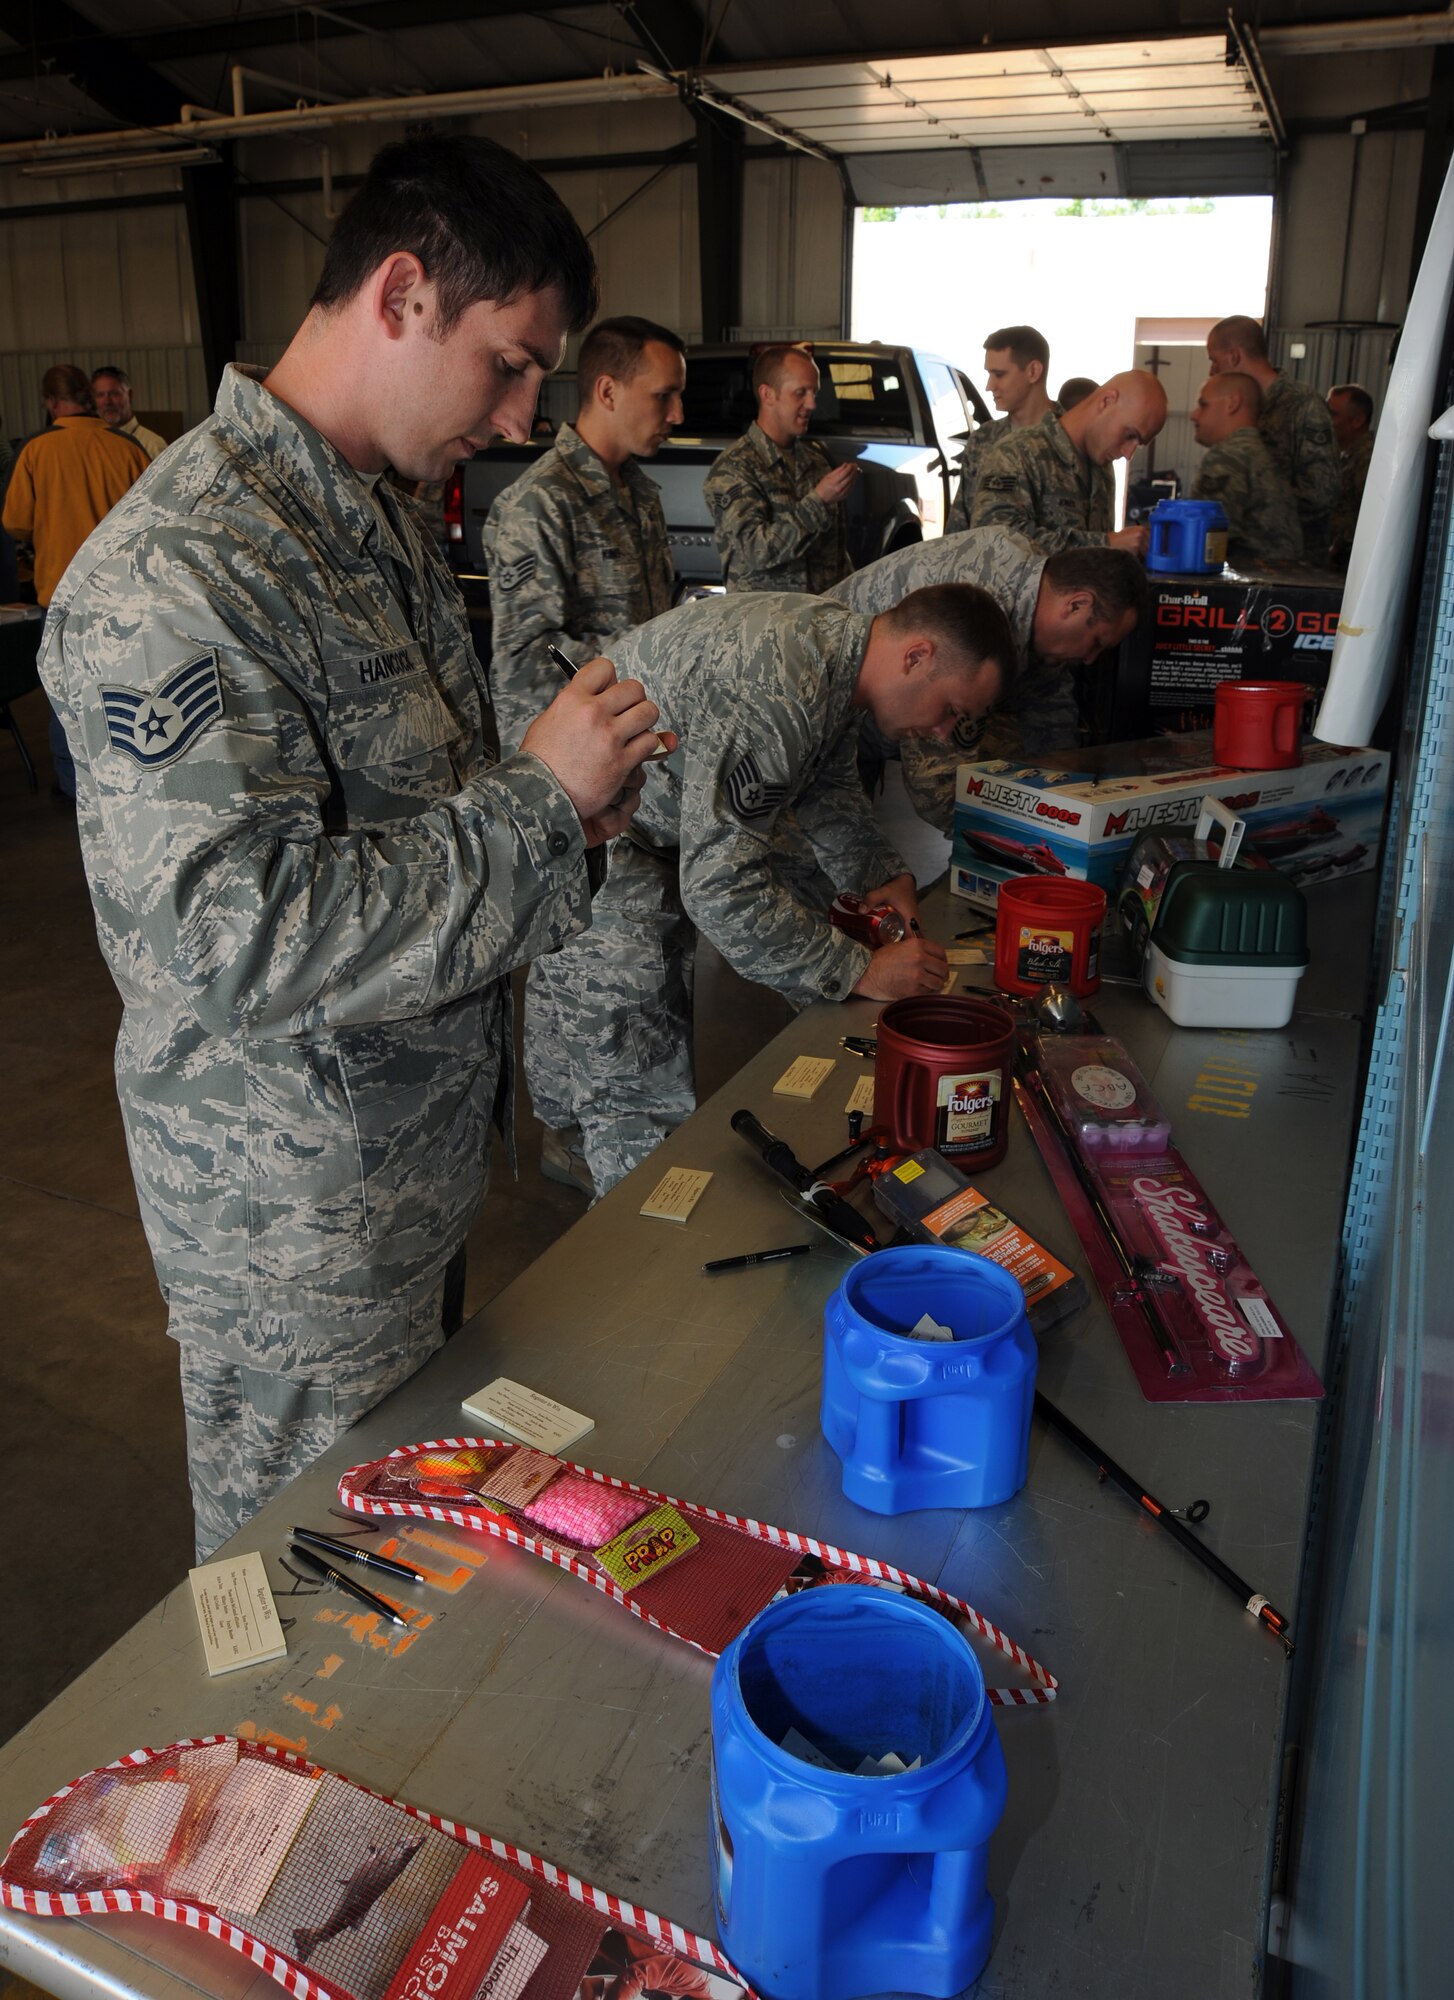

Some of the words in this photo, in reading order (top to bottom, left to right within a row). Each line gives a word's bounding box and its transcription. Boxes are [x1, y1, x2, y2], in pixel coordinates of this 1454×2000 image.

[1158, 594, 1208, 606] Char-Broil
[1157, 605, 1260, 630] GRILL
[1270, 609, 1286, 630] 2
[359, 649, 415, 683] HANCOCK
[967, 776, 1040, 813] MAJESTY
[1036, 802, 1081, 825] 800S
[1218, 791, 1261, 810] 00S
[1028, 938, 1064, 956] Folgers
[947, 1095, 994, 1114] Folgers
[951, 1119, 988, 1130] GOURMET
[985, 1235, 1019, 1261] MULTIPL
[999, 1241, 1034, 1268] MULTI-SP
[1128, 1177, 1254, 1359] Shakespeare
[257, 1587, 267, 1605] Register
[262, 1609, 272, 1620] Win
[399, 1924, 452, 2000] BASIC
[477, 1945, 521, 2000] Thunde
